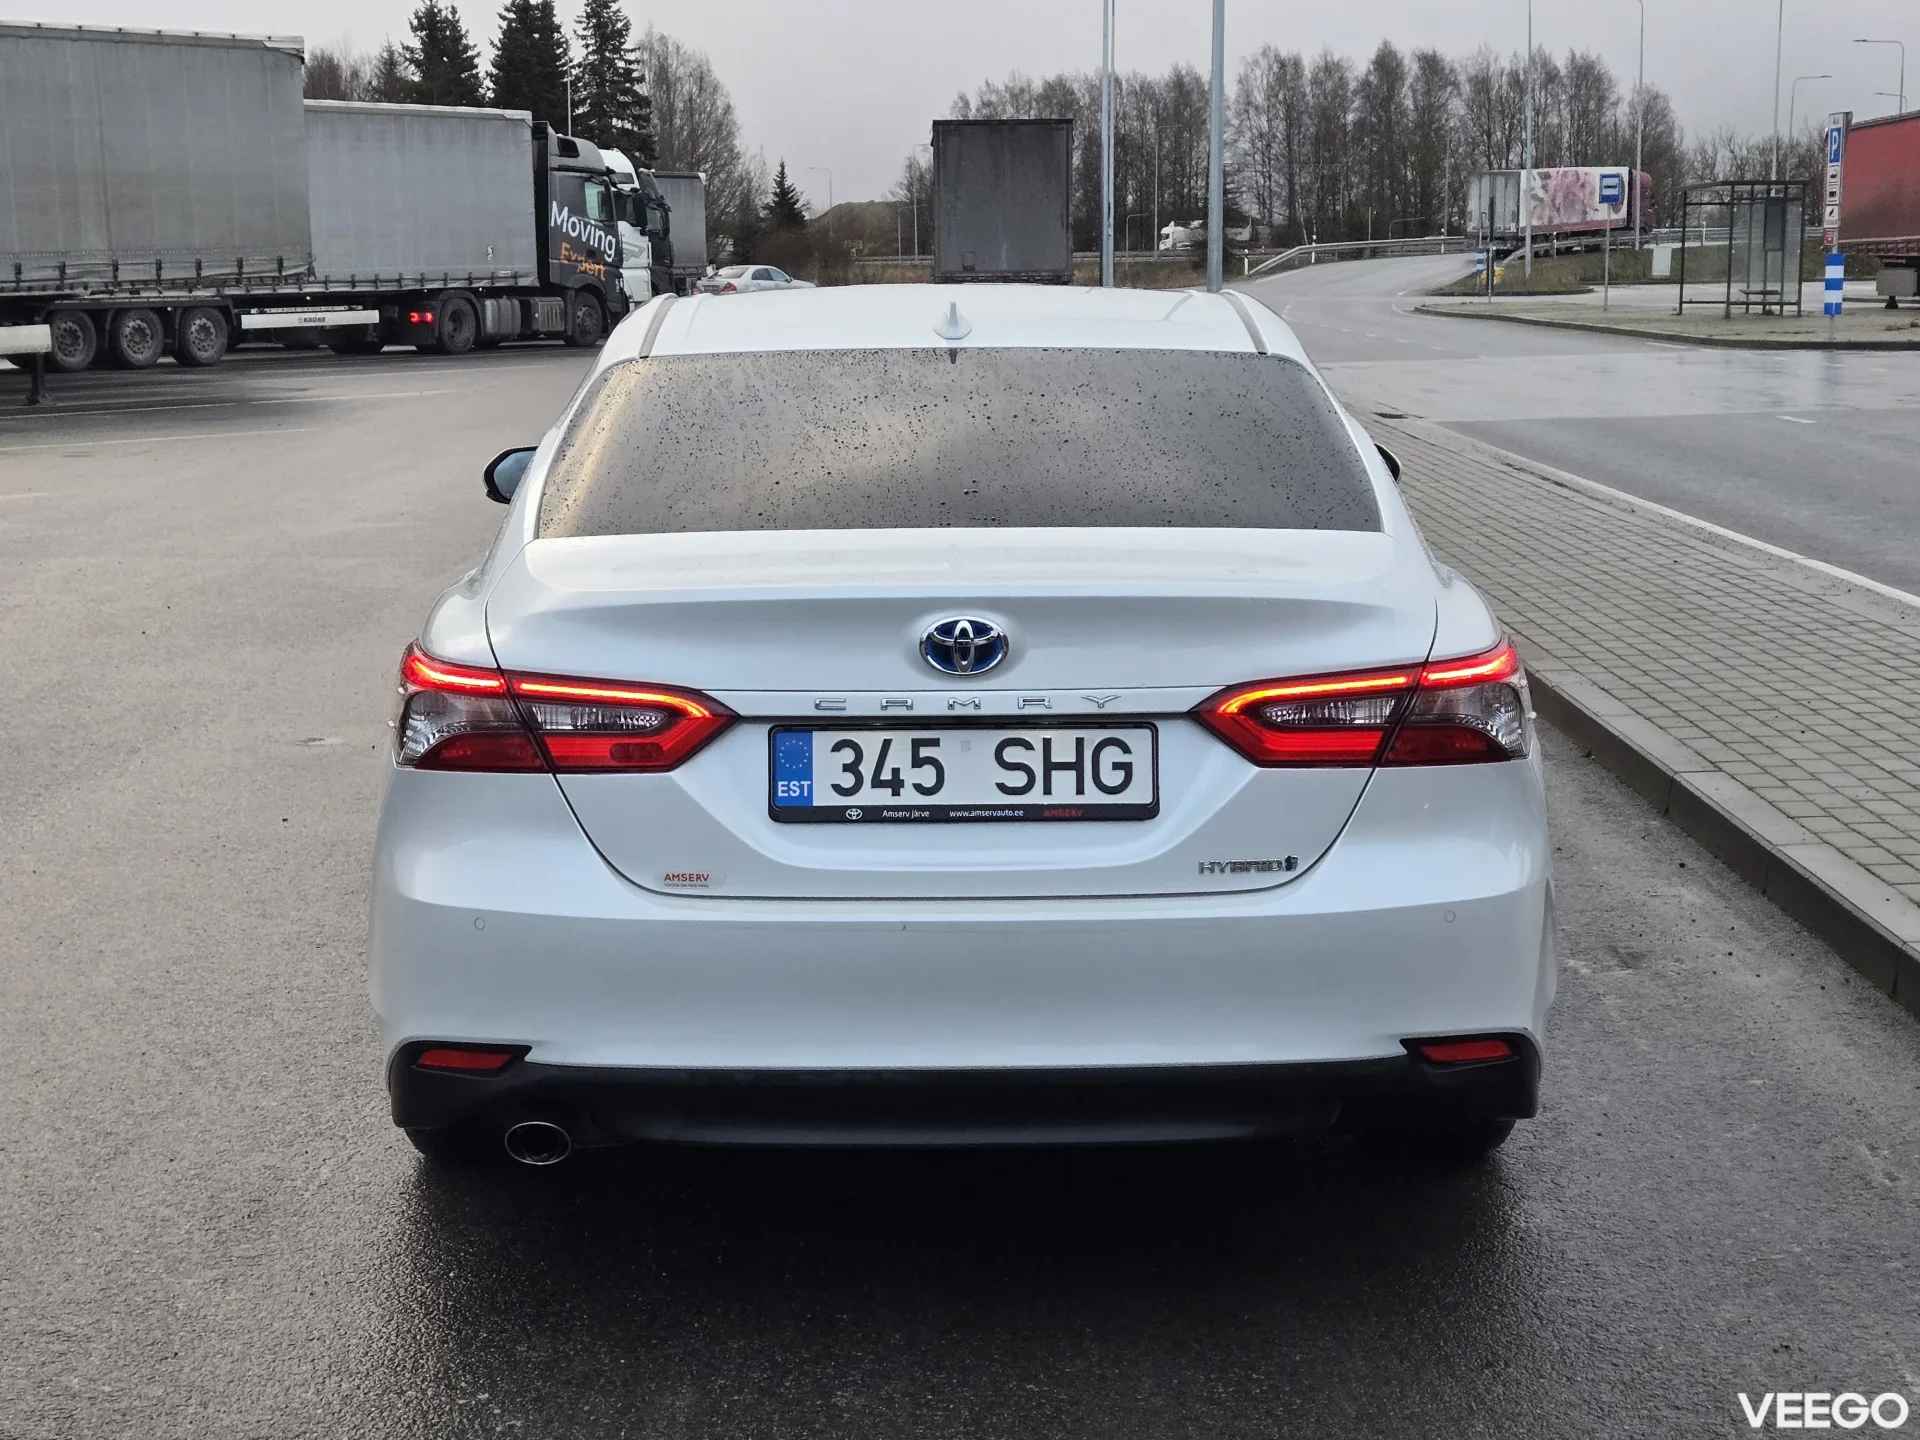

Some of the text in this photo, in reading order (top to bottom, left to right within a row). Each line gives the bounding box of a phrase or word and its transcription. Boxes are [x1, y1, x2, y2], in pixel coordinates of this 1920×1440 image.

[551, 200, 616, 262] Moving
[814, 694, 1122, 711] CAMRY
[830, 736, 1134, 797] 345 SHG
[777, 781, 812, 797] EST
[882, 810, 910, 818] Amserv
[949, 809, 1024, 818] www.amservauto.ee
[1198, 858, 1283, 875] HYBRID
[664, 873, 710, 882] AMSERV
